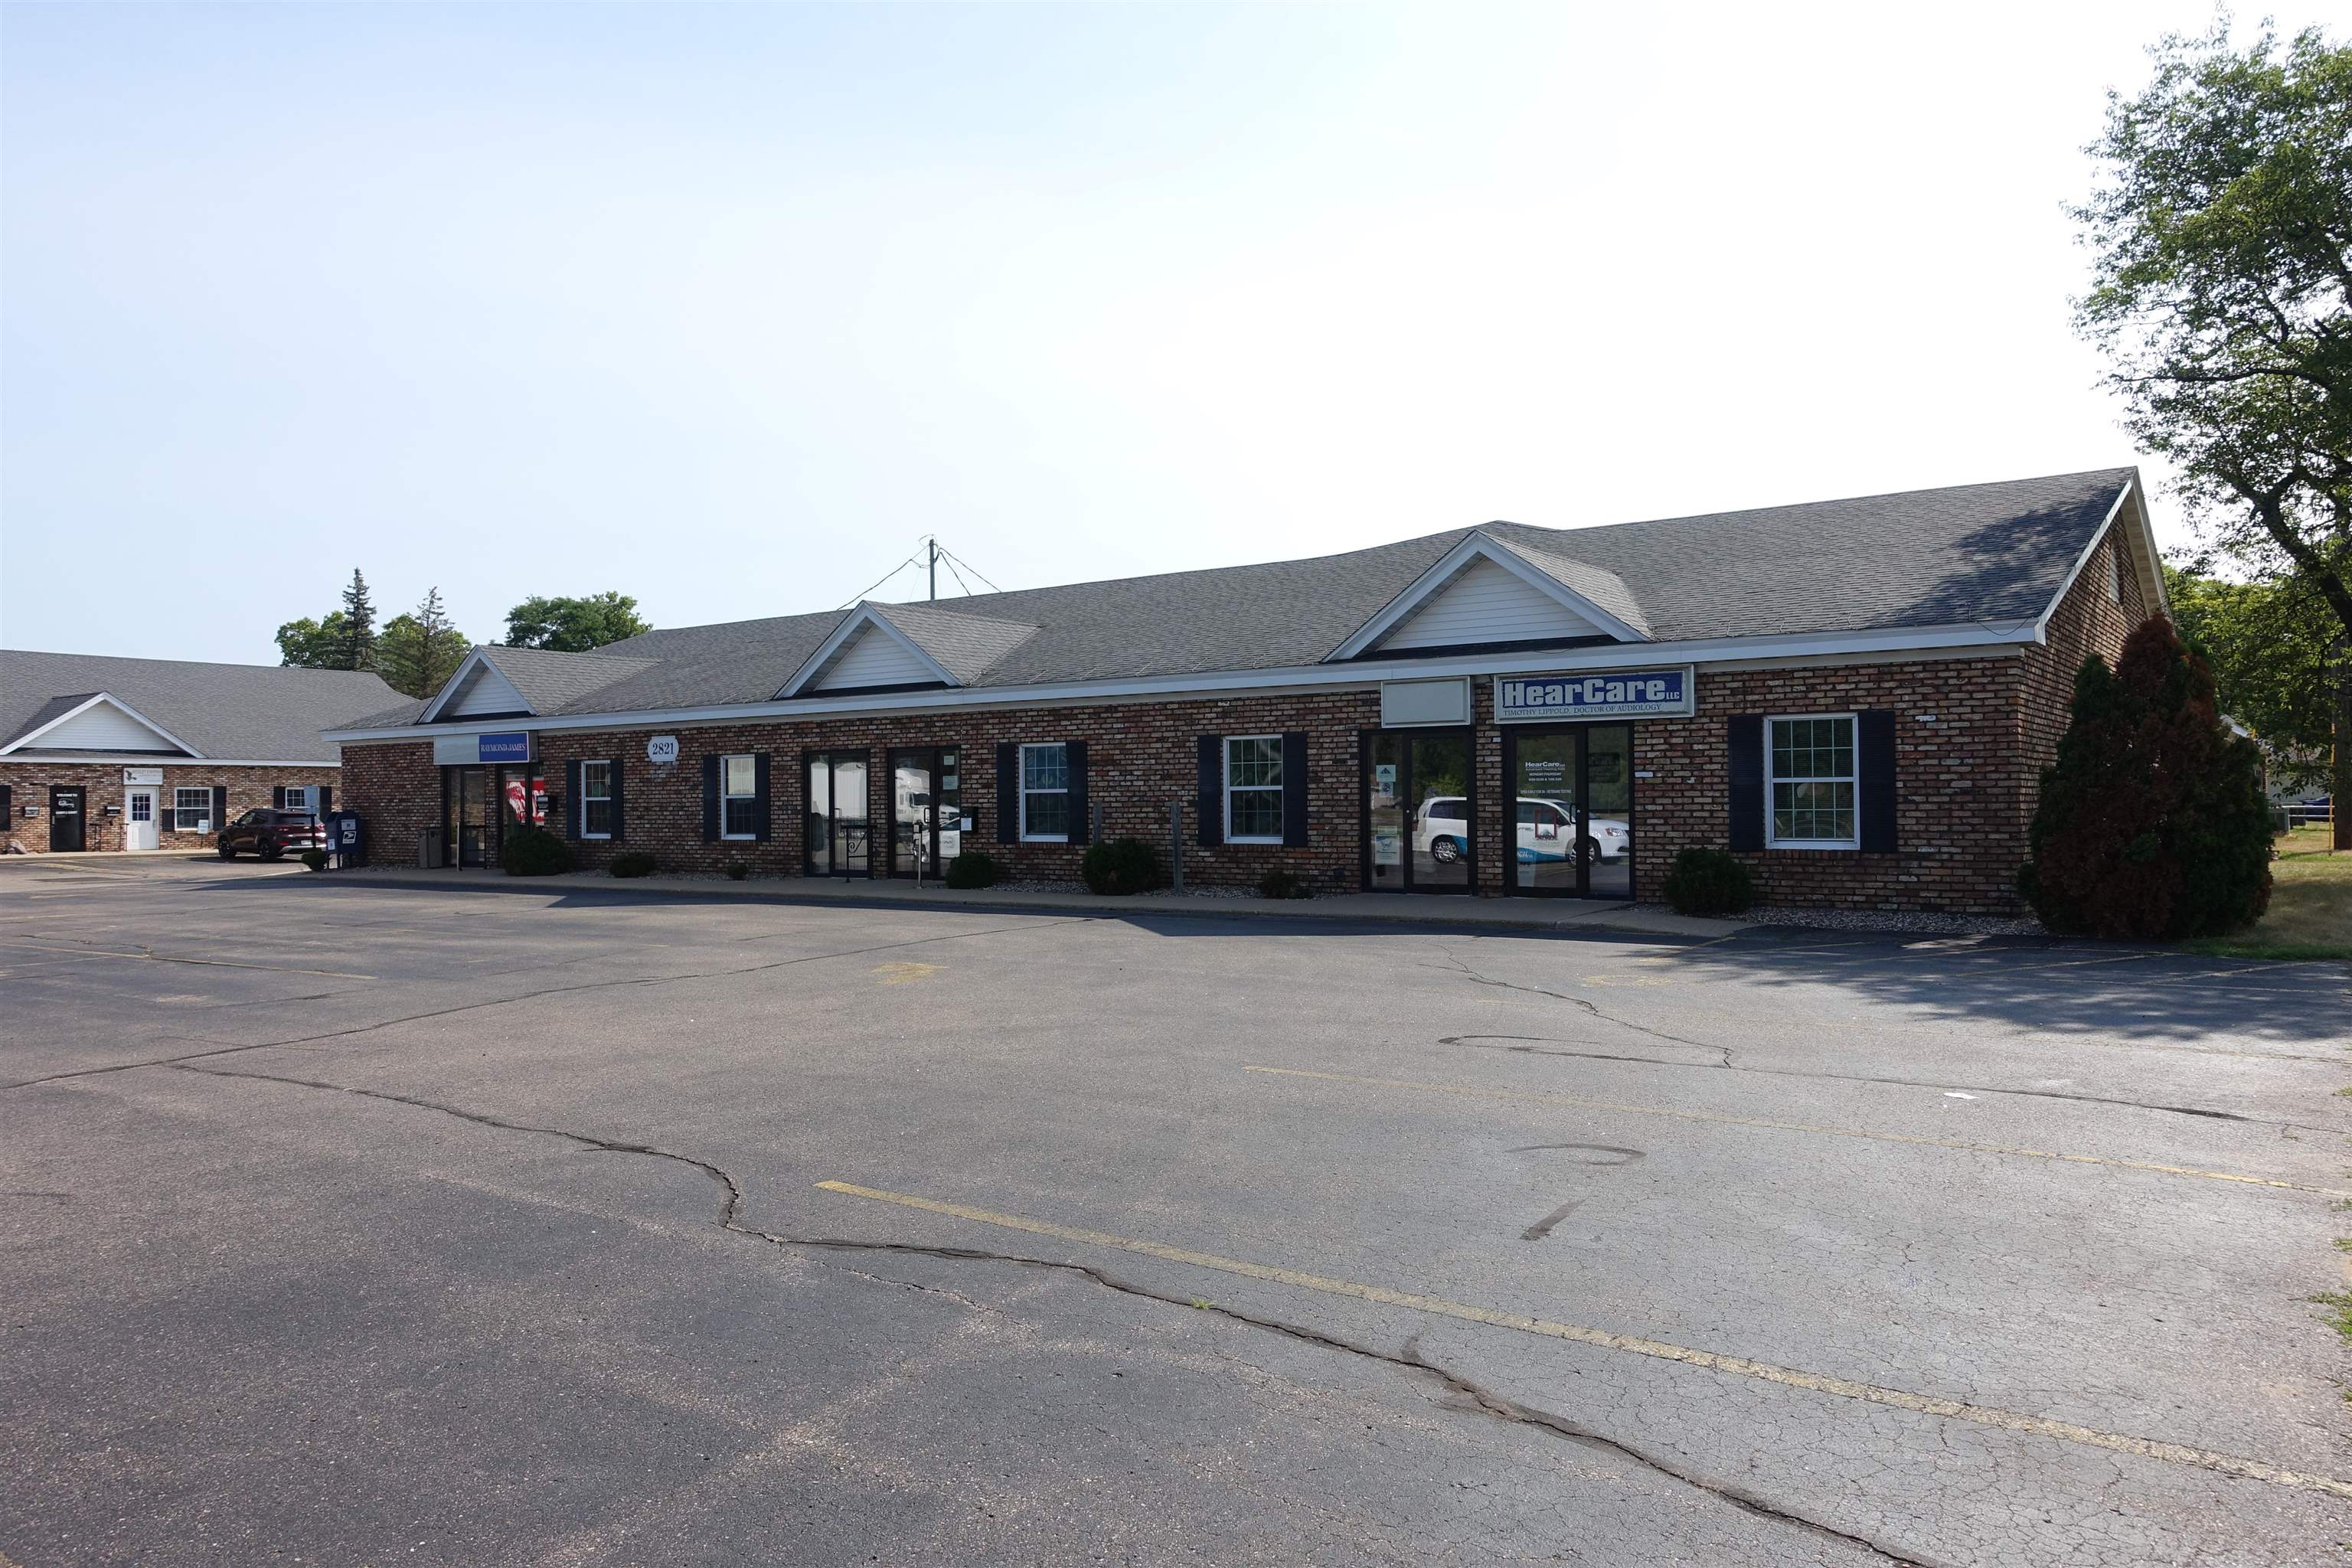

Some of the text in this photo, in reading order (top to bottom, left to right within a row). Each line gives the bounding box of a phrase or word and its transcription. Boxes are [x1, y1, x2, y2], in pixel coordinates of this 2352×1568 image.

[1504, 678, 1680, 707] HearCare LLC
[1504, 708, 1536, 717] TIMOTHY
[1574, 706, 1604, 714] DOCTOR
[1617, 704, 1661, 712] AUDIOLOGY
[481, 743, 526, 752] RAYMOND JAMES
[652, 742, 674, 755] 2821
